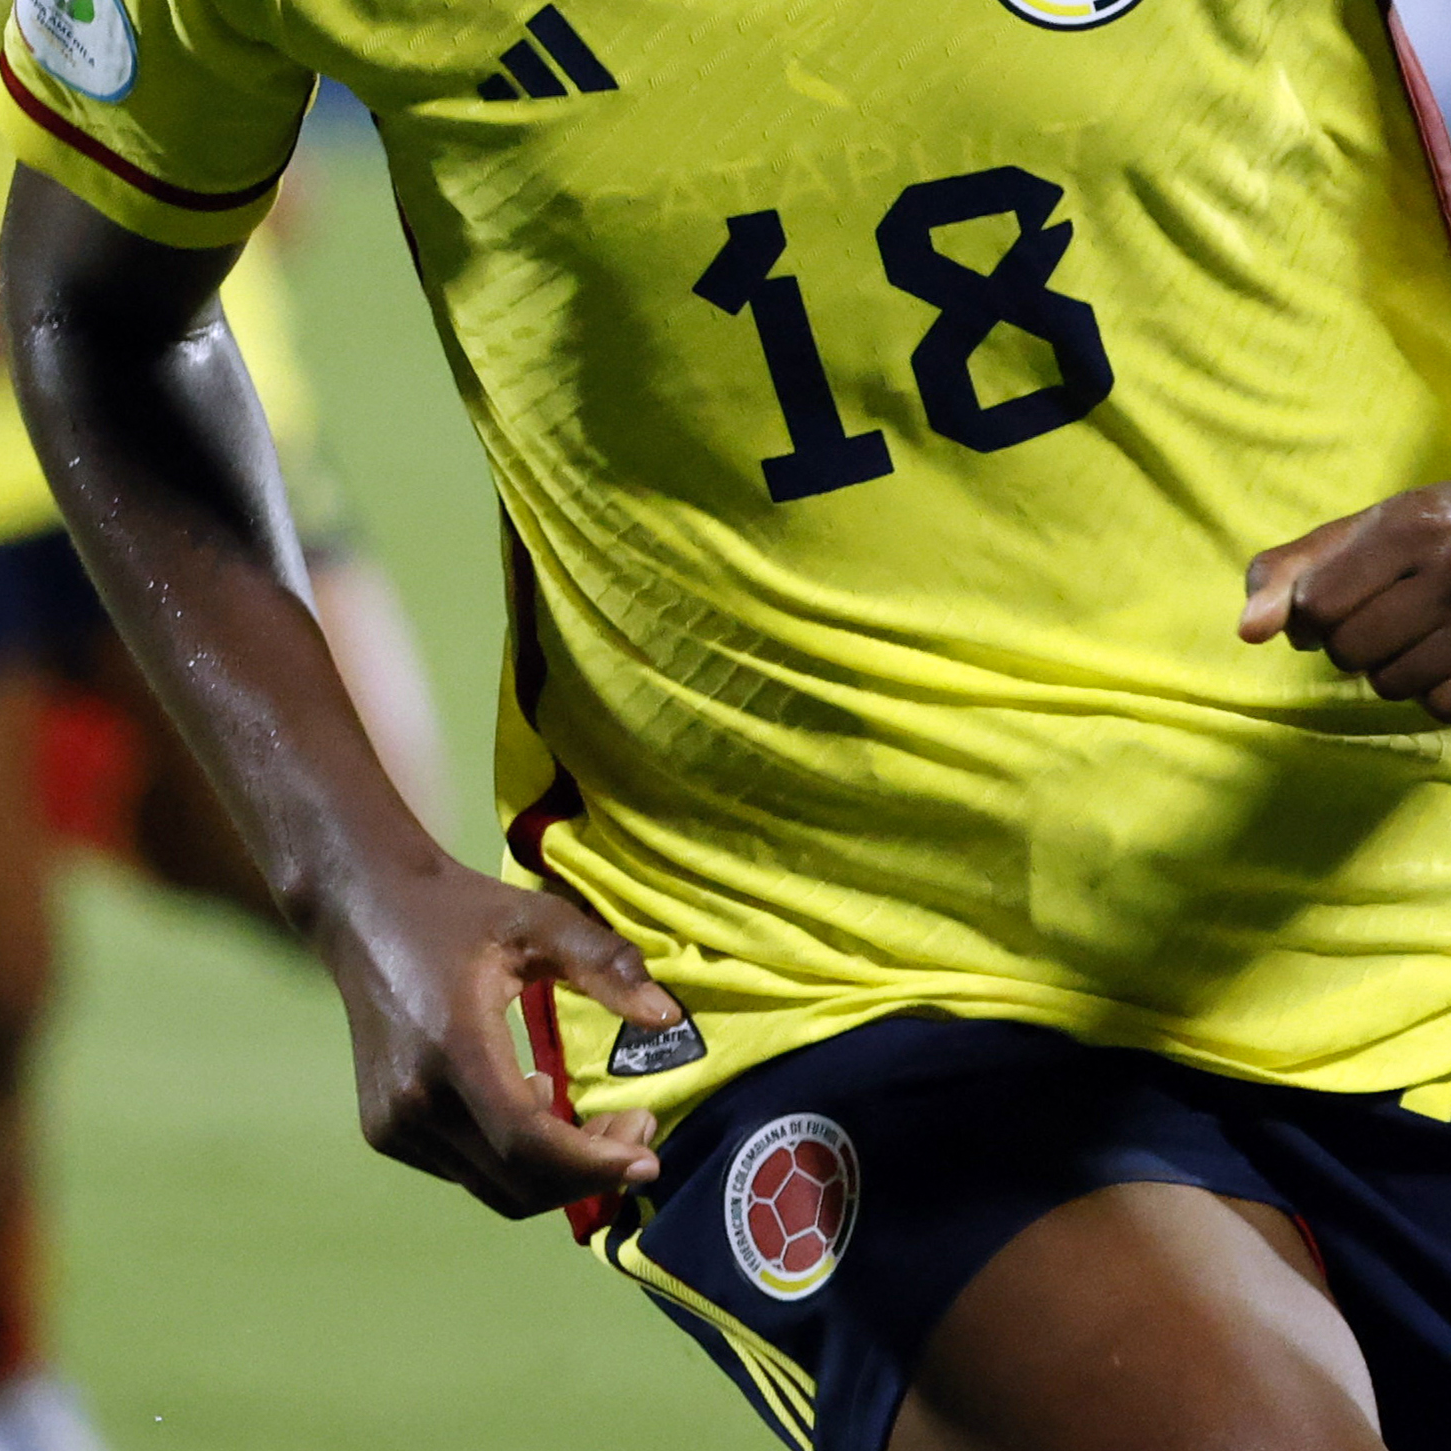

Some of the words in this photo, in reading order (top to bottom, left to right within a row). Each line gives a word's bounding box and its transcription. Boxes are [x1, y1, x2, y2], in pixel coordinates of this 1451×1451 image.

[690, 164, 1115, 504] 18
[732, 1125, 789, 1194] COLOMBIANA
[789, 1120, 801, 1136] DE
